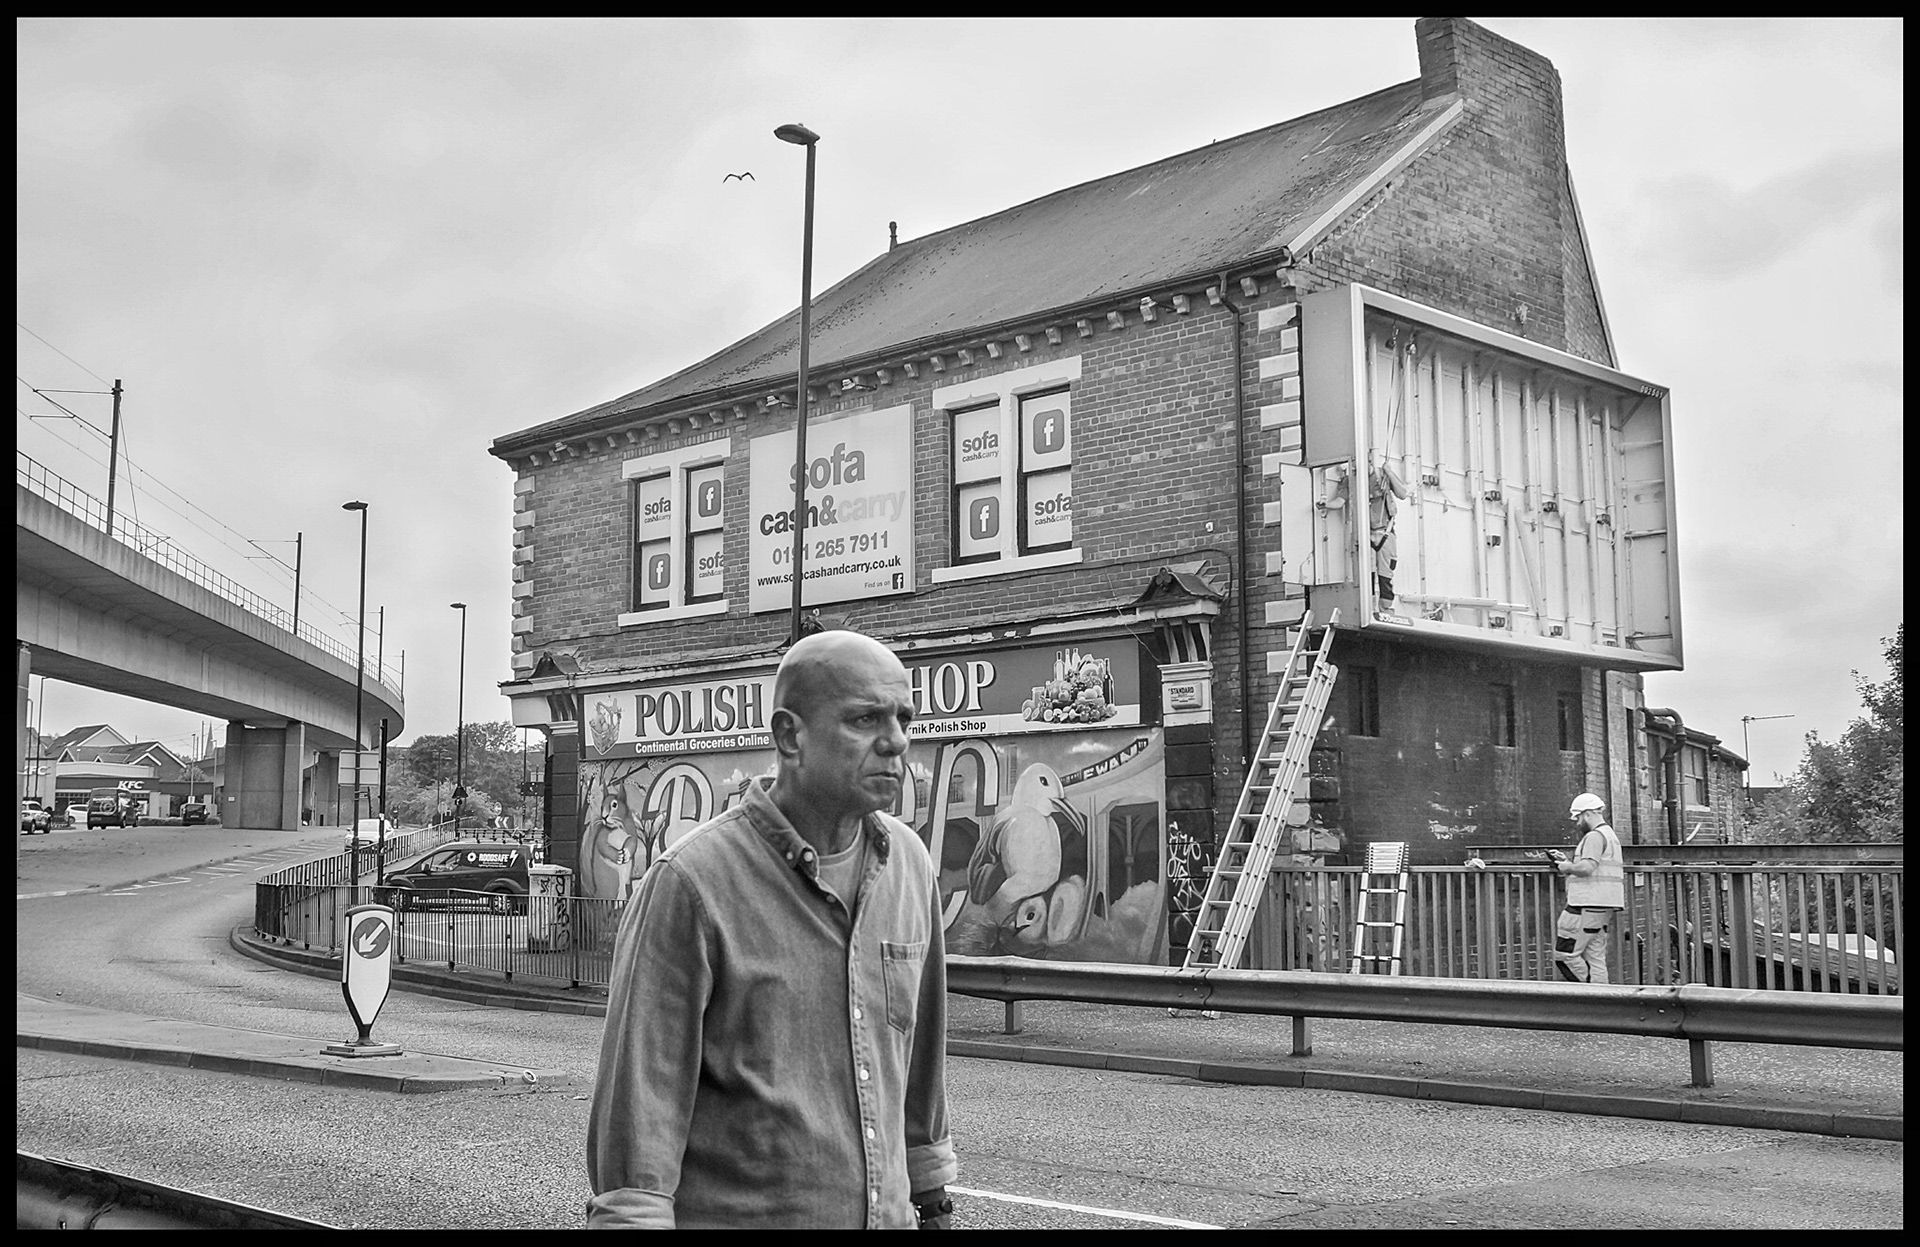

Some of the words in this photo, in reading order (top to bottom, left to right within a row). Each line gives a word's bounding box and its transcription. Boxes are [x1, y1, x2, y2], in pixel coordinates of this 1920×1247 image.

[962, 430, 999, 453] sofa
[962, 450, 999, 463] cash&carry
[644, 497, 671, 516] sofa
[1034, 493, 1071, 516] sofa
[772, 543, 809, 566] 011
[815, 537, 845, 560] 265
[850, 530, 888, 553] 7911
[757, 555, 901, 587] www.socashandcarry.co.uk
[864, 581, 875, 589] Find
[634, 682, 765, 738] POLISH
[905, 660, 996, 716] HOP
[635, 738, 687, 754] Continental
[689, 735, 736, 750] Groceries
[738, 733, 770, 747] Online
[929, 721, 959, 733] Polish
[960, 719, 987, 733] Shop
[117, 780, 145, 790] KFC
